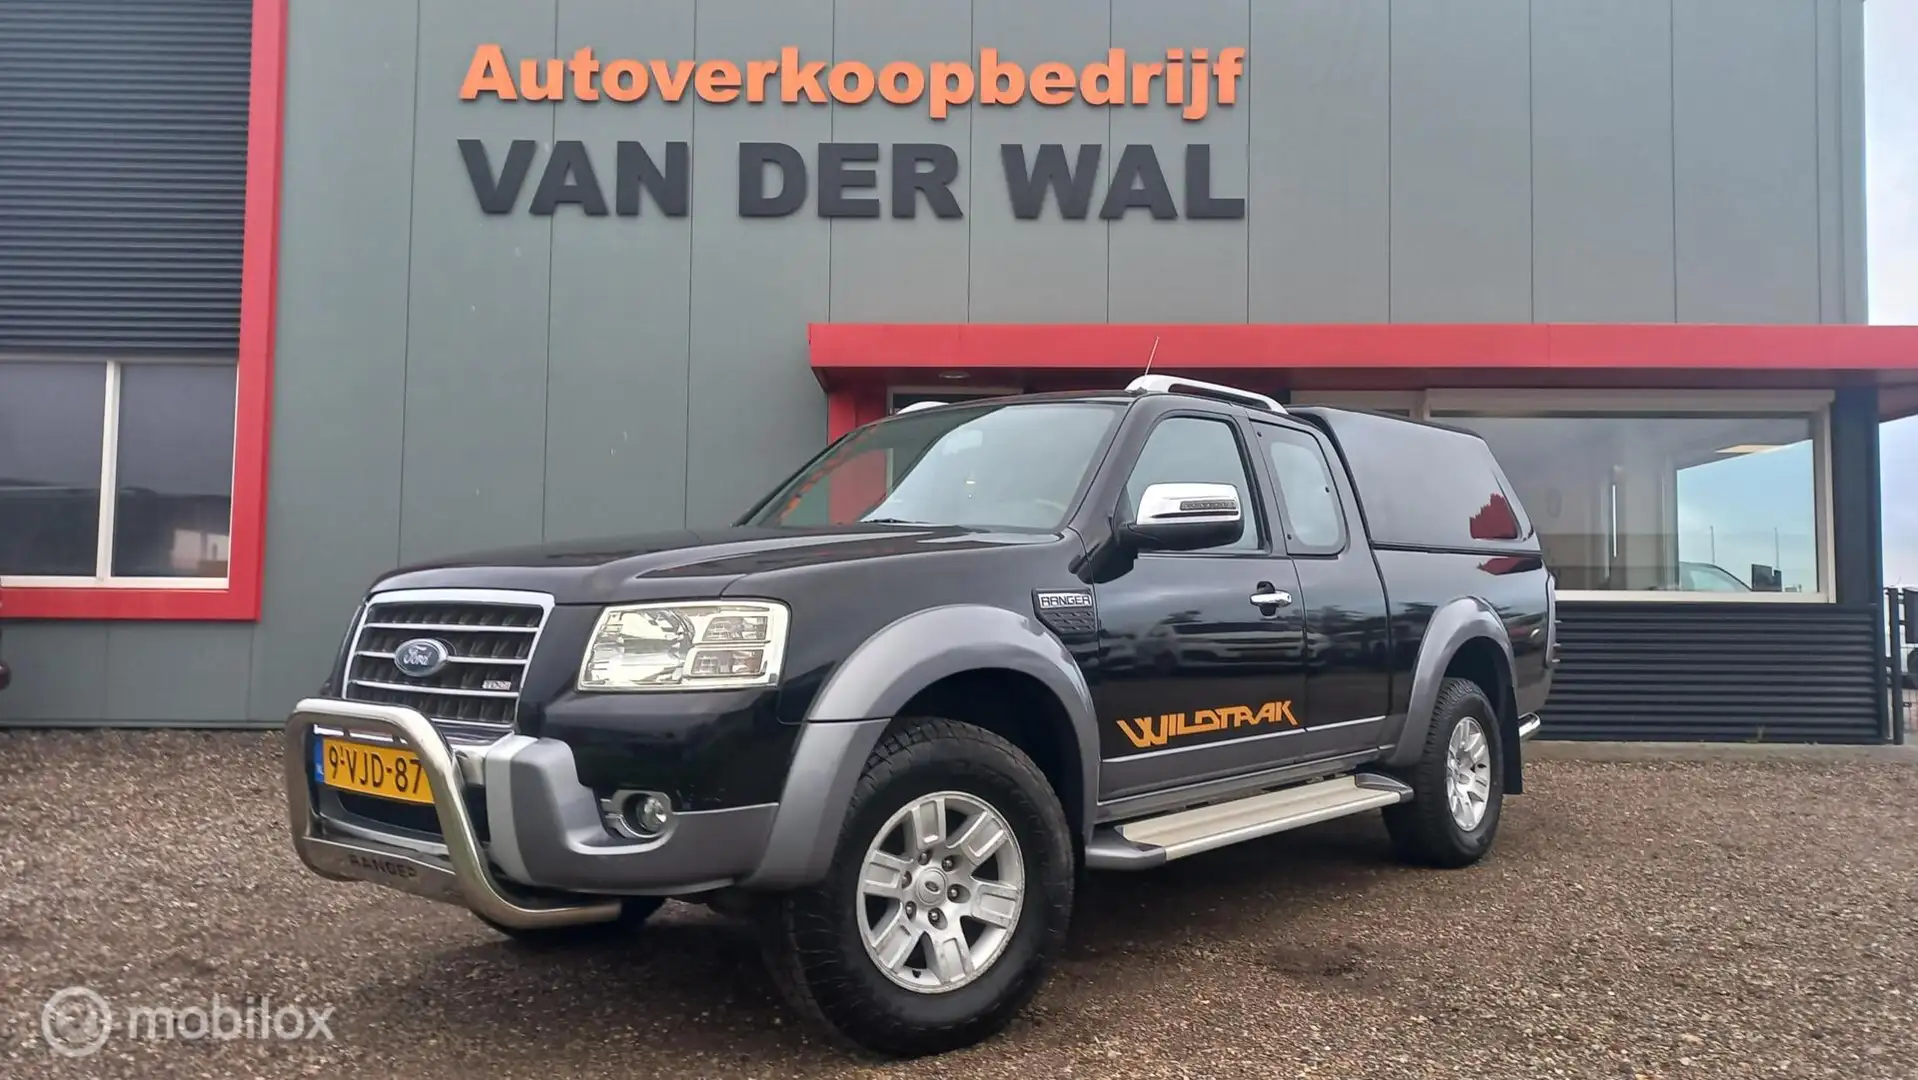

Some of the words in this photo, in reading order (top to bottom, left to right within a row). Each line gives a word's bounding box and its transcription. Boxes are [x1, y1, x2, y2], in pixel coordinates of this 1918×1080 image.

[458, 44, 1246, 121] Autoverkoopbedrijf
[457, 138, 690, 217] VAN
[738, 142, 965, 220] DER
[1000, 143, 1246, 221] WAL
[1040, 595, 1091, 607] RANGER
[403, 645, 432, 666] Ford
[1116, 700, 1298, 748] WILDTRAK
[328, 745, 423, 794] 9-VJD-87
